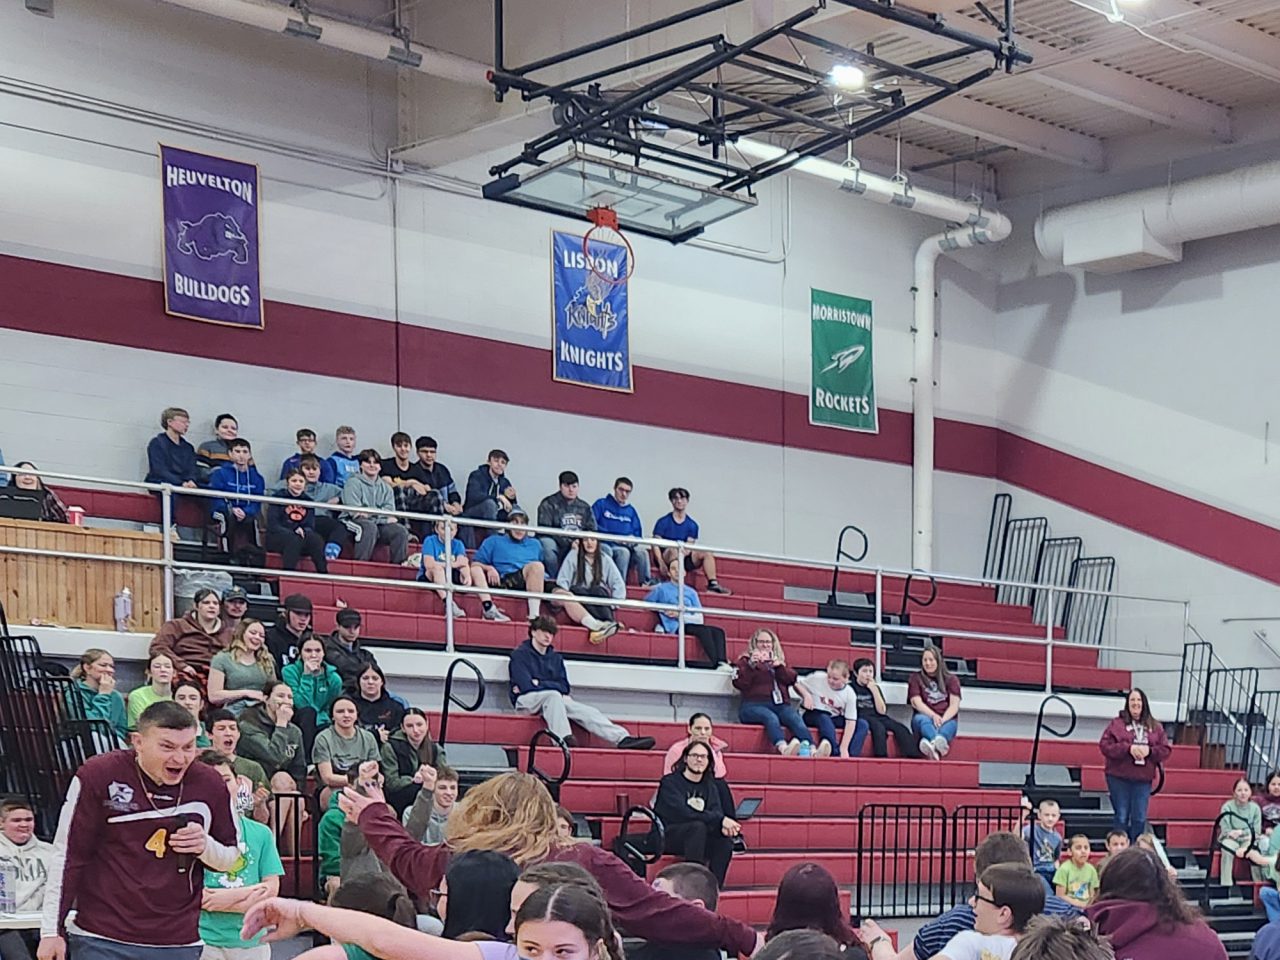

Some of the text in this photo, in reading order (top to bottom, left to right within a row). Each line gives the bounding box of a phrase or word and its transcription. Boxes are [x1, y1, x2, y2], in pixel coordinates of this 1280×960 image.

[166, 164, 254, 206] HEUVELTON
[174, 272, 250, 307] BULLDOGS
[812, 303, 872, 331] MORRISTOWN
[560, 340, 624, 371] KNIGHTS
[815, 386, 870, 415] ROCKETS
[145, 828, 167, 858] 4
